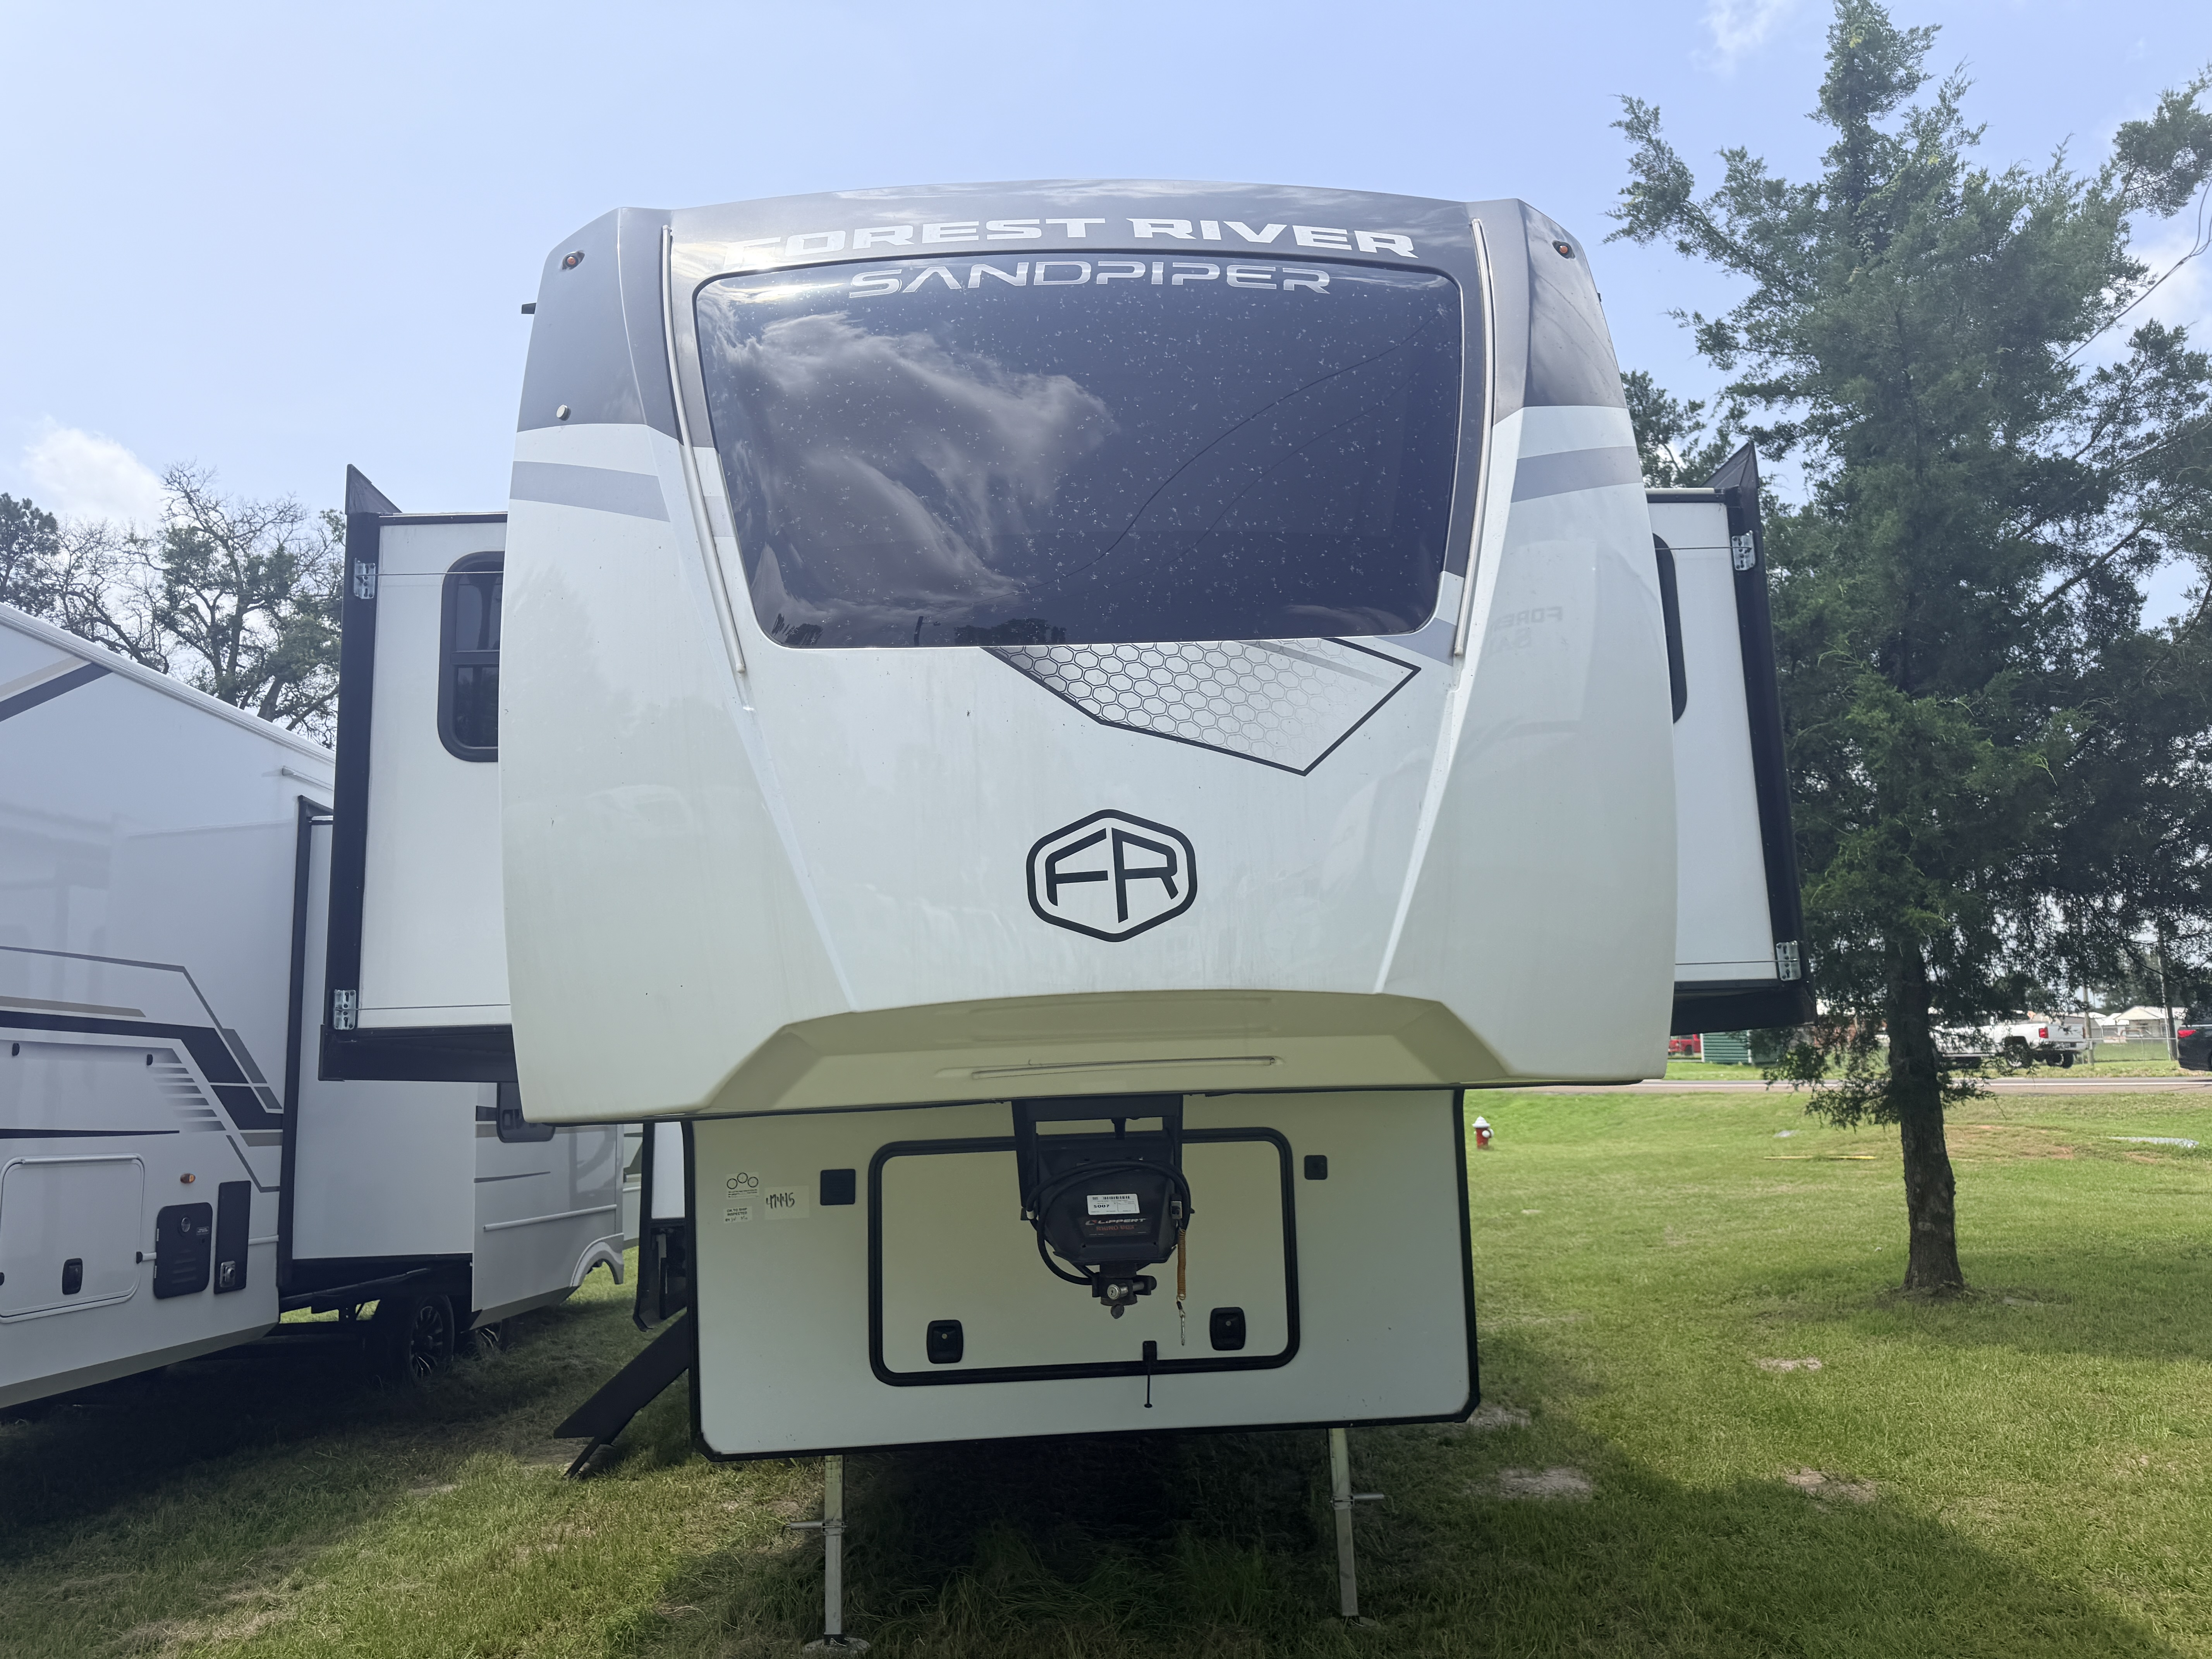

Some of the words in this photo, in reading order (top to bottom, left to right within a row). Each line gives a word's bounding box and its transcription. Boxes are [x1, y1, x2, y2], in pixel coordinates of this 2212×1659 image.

[722, 218, 1106, 267] FOREST
[1126, 218, 1419, 259] RIVER
[849, 260, 1331, 299] SANDPIPER
